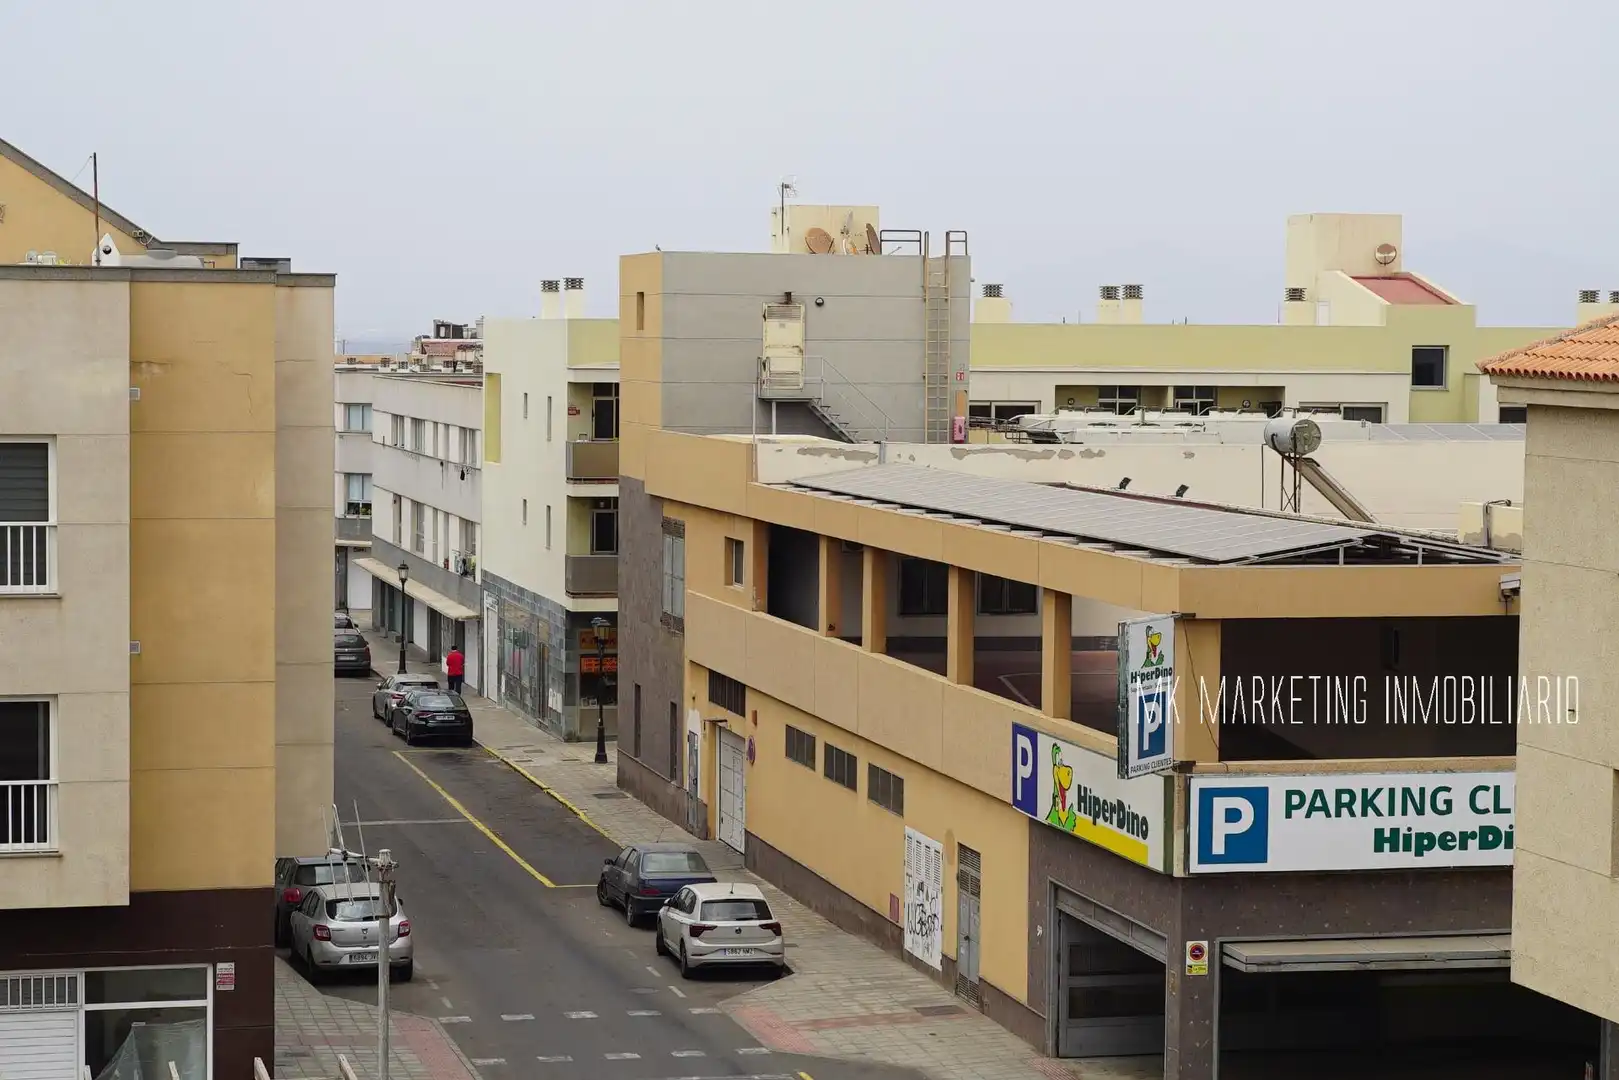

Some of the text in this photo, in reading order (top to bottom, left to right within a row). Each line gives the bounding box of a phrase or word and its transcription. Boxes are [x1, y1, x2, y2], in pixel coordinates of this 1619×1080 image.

[1016, 733, 1033, 801] P
[1130, 757, 1172, 774] PARKING CLIENTES
[1077, 784, 1149, 841] HiperDino
[1285, 784, 1516, 819] PARKING CL
[1211, 796, 1255, 855] P
[1373, 823, 1514, 857] HiperDi
